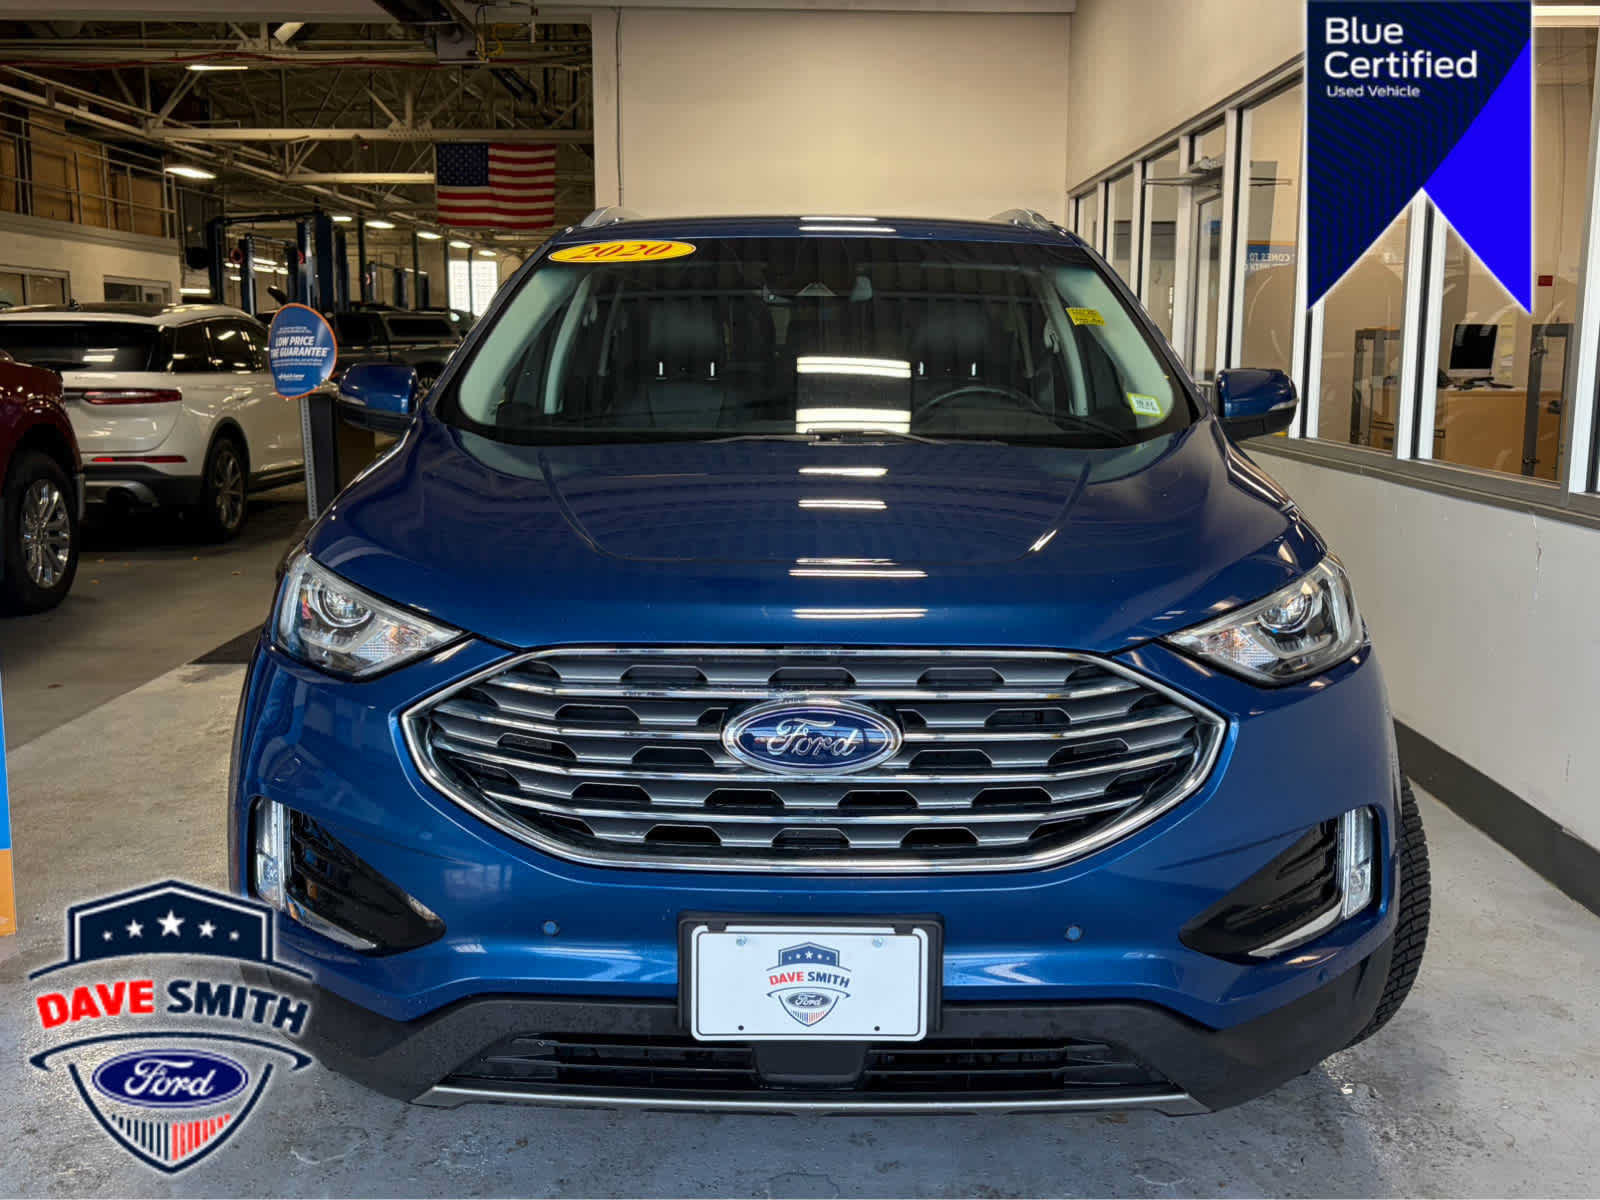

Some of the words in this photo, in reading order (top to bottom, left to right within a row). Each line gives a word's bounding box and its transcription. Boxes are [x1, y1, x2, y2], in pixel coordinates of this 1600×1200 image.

[567, 243, 673, 260] 2020
[275, 336, 289, 348] LOW
[289, 335, 316, 347] PRICE
[279, 346, 328, 358] GUARANTEE
[766, 717, 857, 757] Ford
[769, 971, 804, 986] DAVE
[807, 971, 850, 989] SMITH
[795, 993, 824, 1007] Ford
